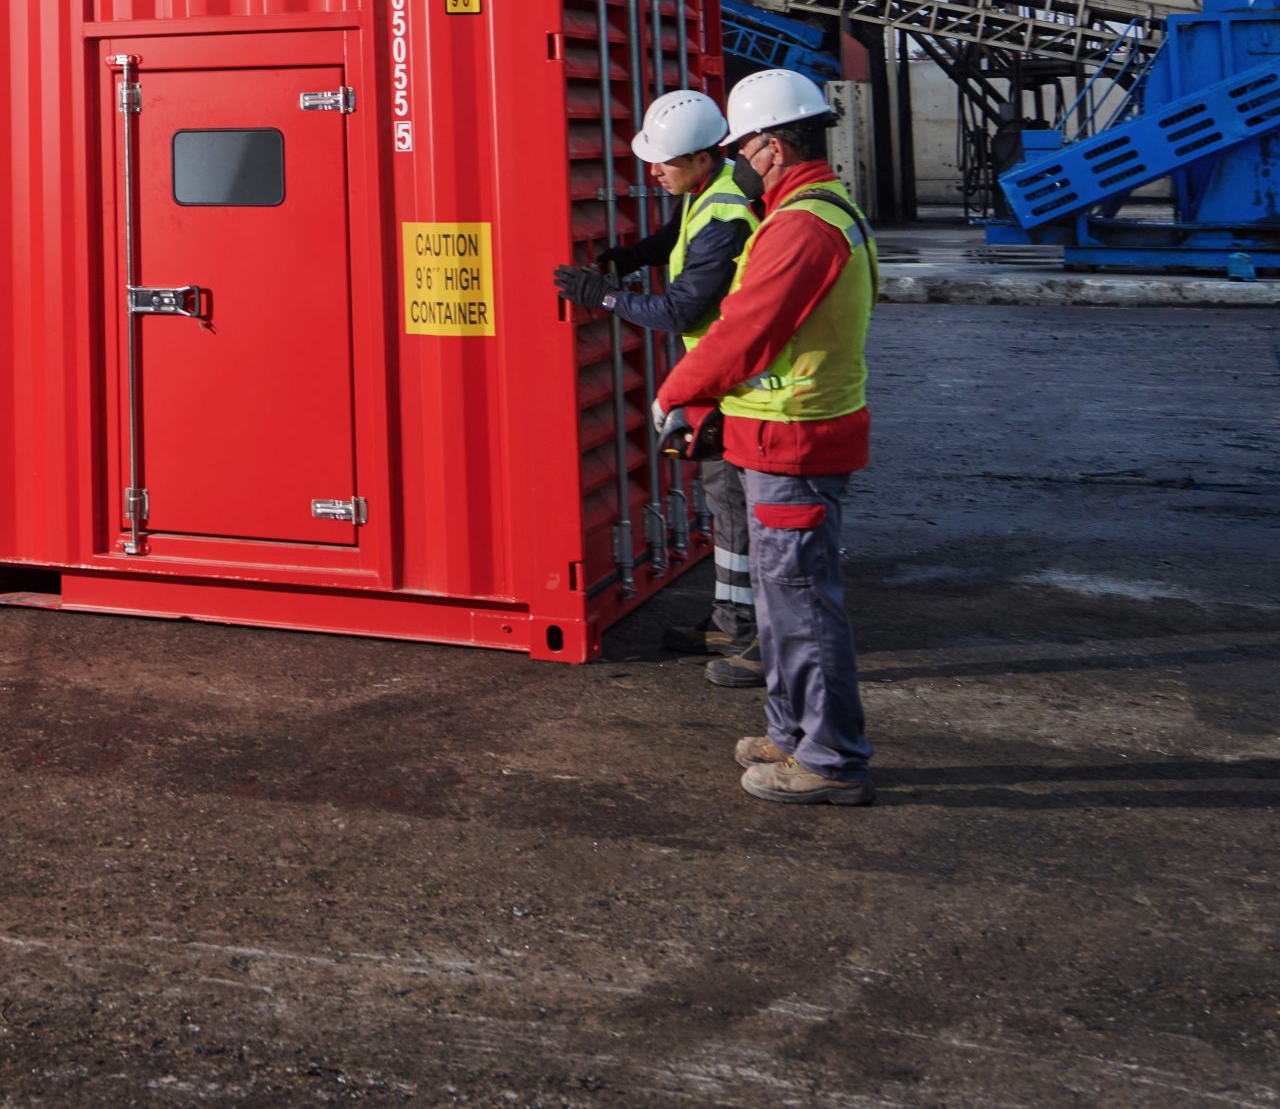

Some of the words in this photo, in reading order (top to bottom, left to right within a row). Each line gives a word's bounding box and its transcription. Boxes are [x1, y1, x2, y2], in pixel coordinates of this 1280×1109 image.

[396, 123, 411, 150] 5
[415, 233, 479, 257] CAUTION
[444, 267, 481, 291] HIGH
[410, 300, 489, 325] CONTAINER
